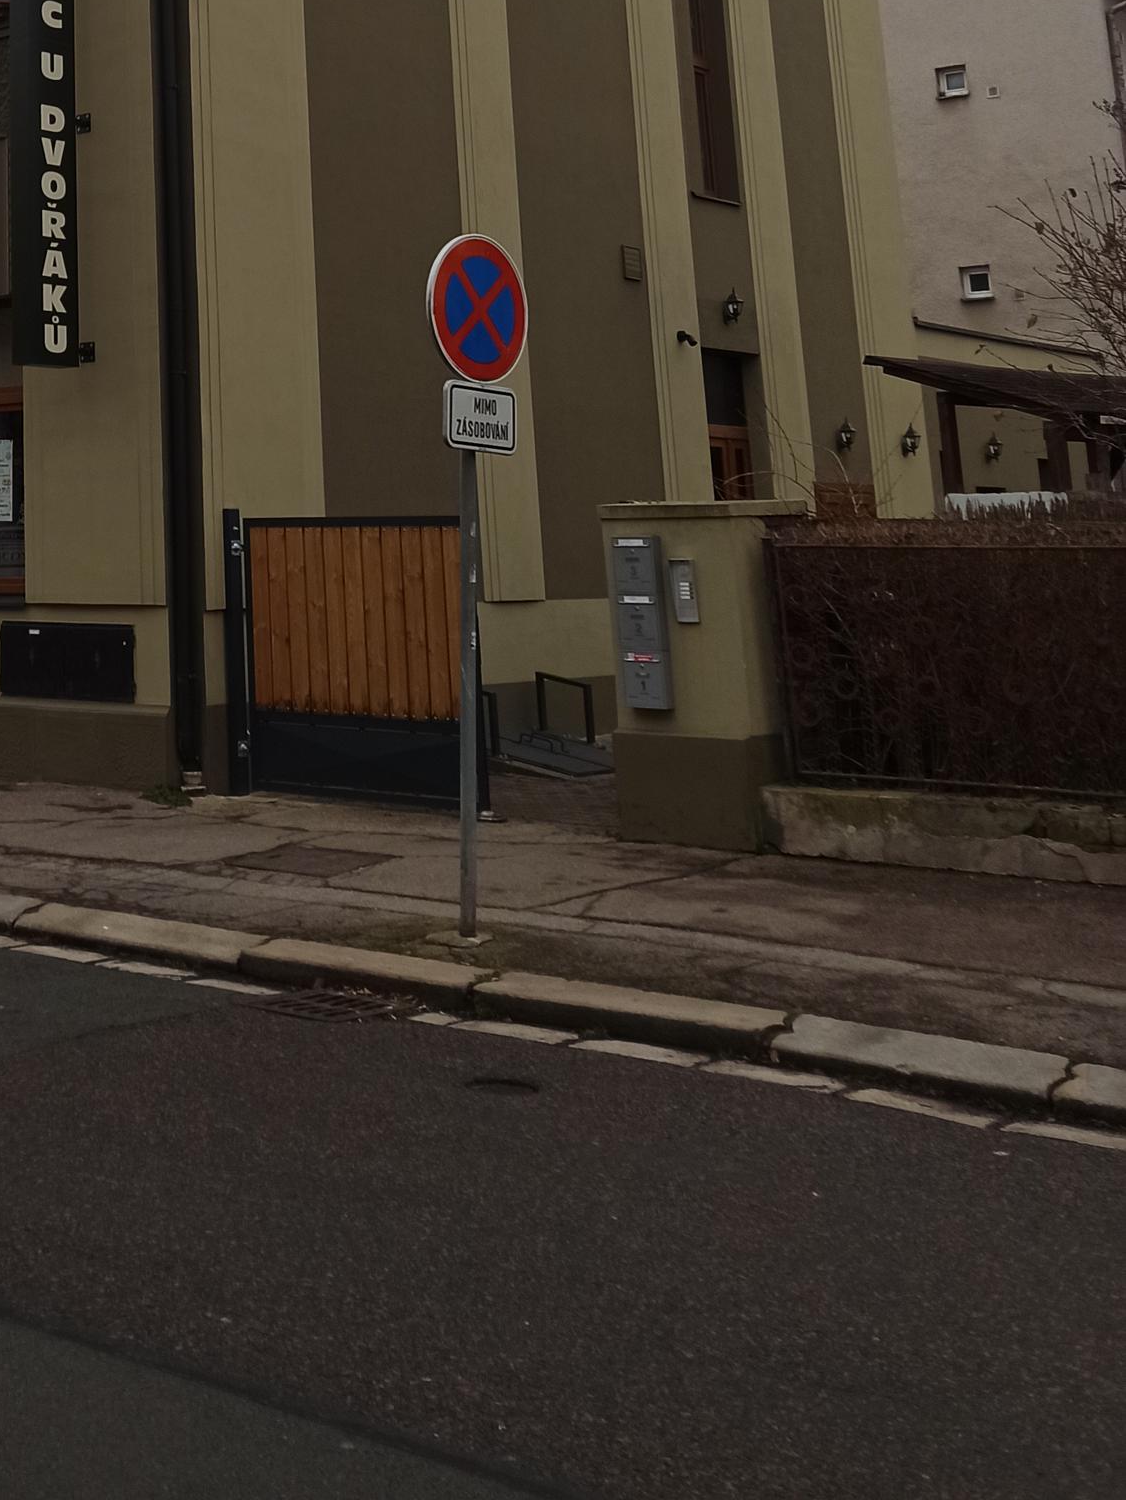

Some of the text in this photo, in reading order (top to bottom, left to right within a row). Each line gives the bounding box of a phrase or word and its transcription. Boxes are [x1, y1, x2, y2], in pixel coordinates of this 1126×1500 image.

[40, 51, 64, 81] U
[40, 103, 68, 354] DVOŘÁKŮ
[474, 397, 497, 416] MIMO
[456, 417, 509, 441] ZÁSOBOVÁNÍ
